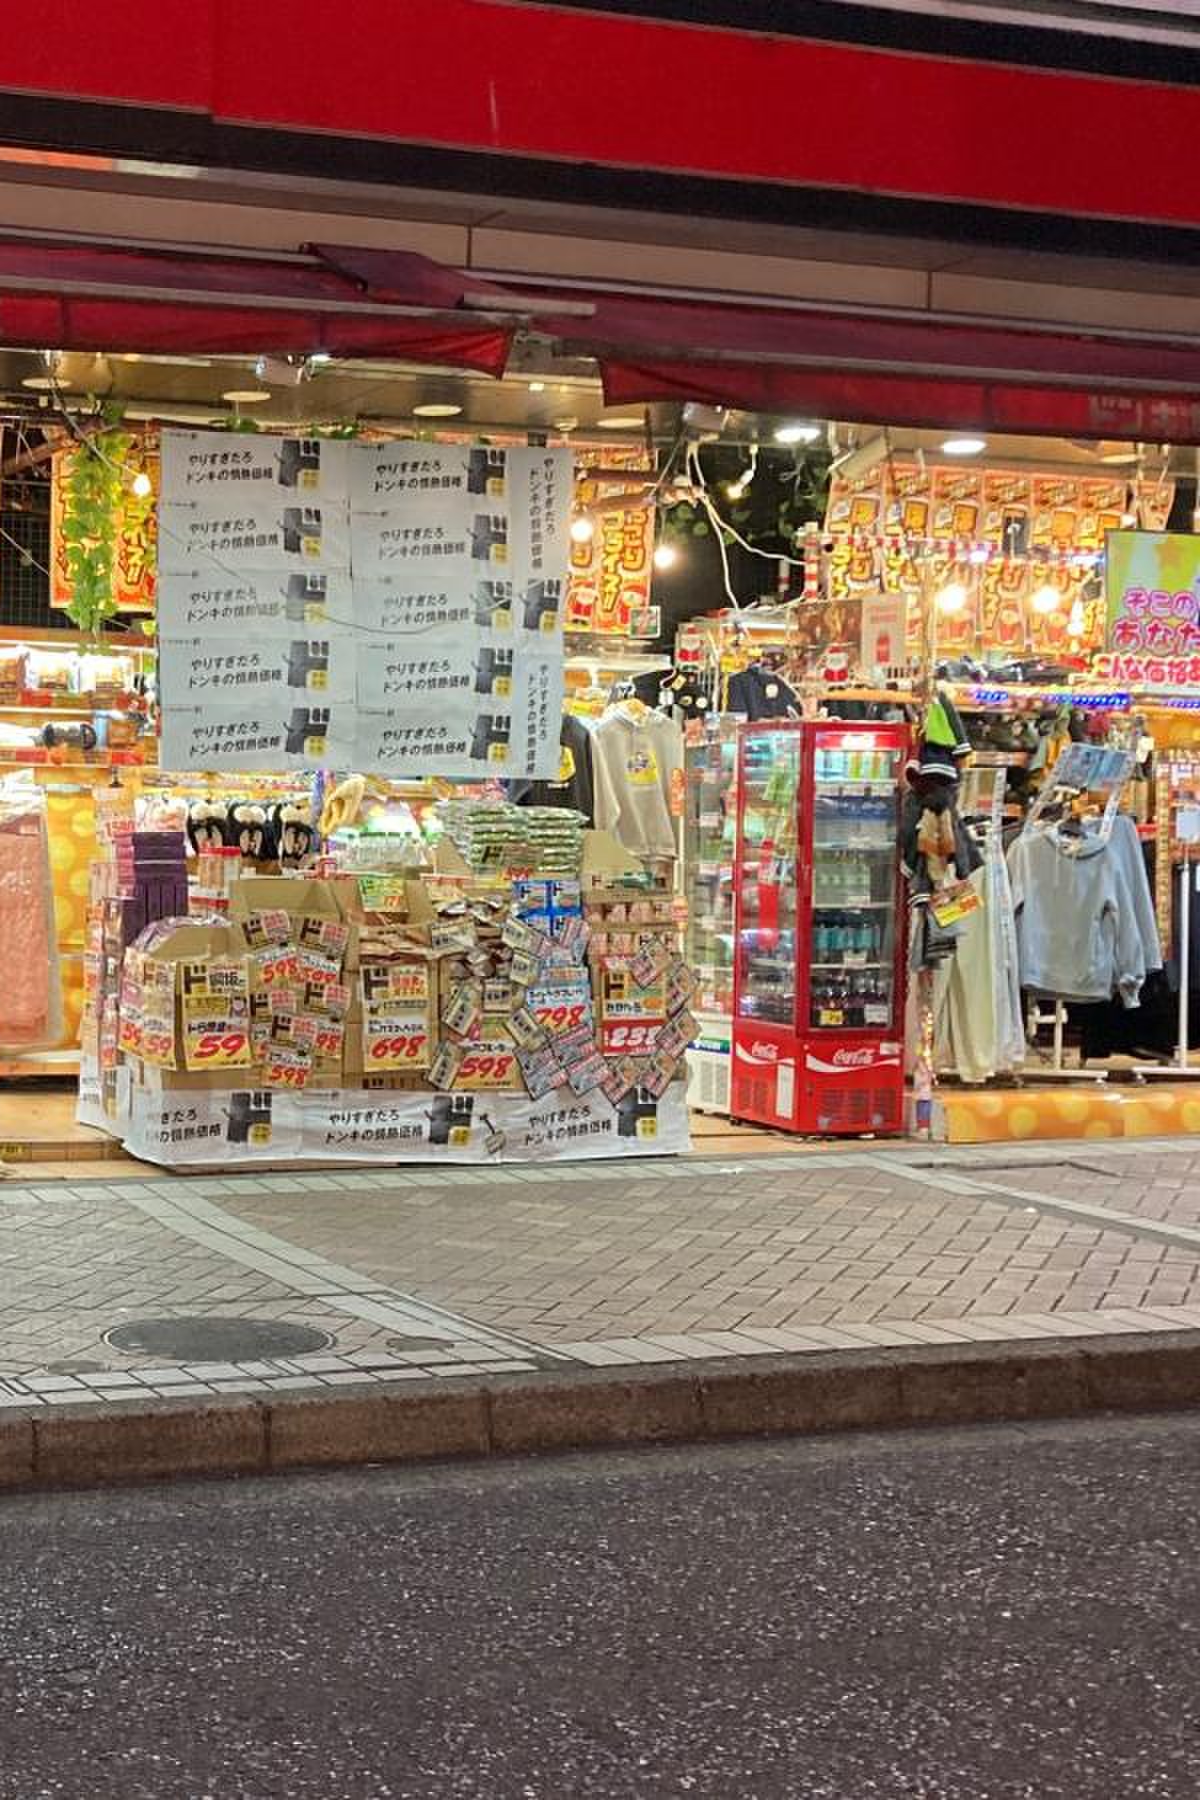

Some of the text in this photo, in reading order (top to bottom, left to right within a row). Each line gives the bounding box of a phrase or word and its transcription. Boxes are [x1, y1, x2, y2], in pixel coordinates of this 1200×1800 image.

[1125, 589, 1194, 616] そこの
[535, 1004, 586, 1028] 798
[193, 1034, 246, 1058] 59
[371, 1035, 427, 1059] 698
[457, 1056, 514, 1079] 598
